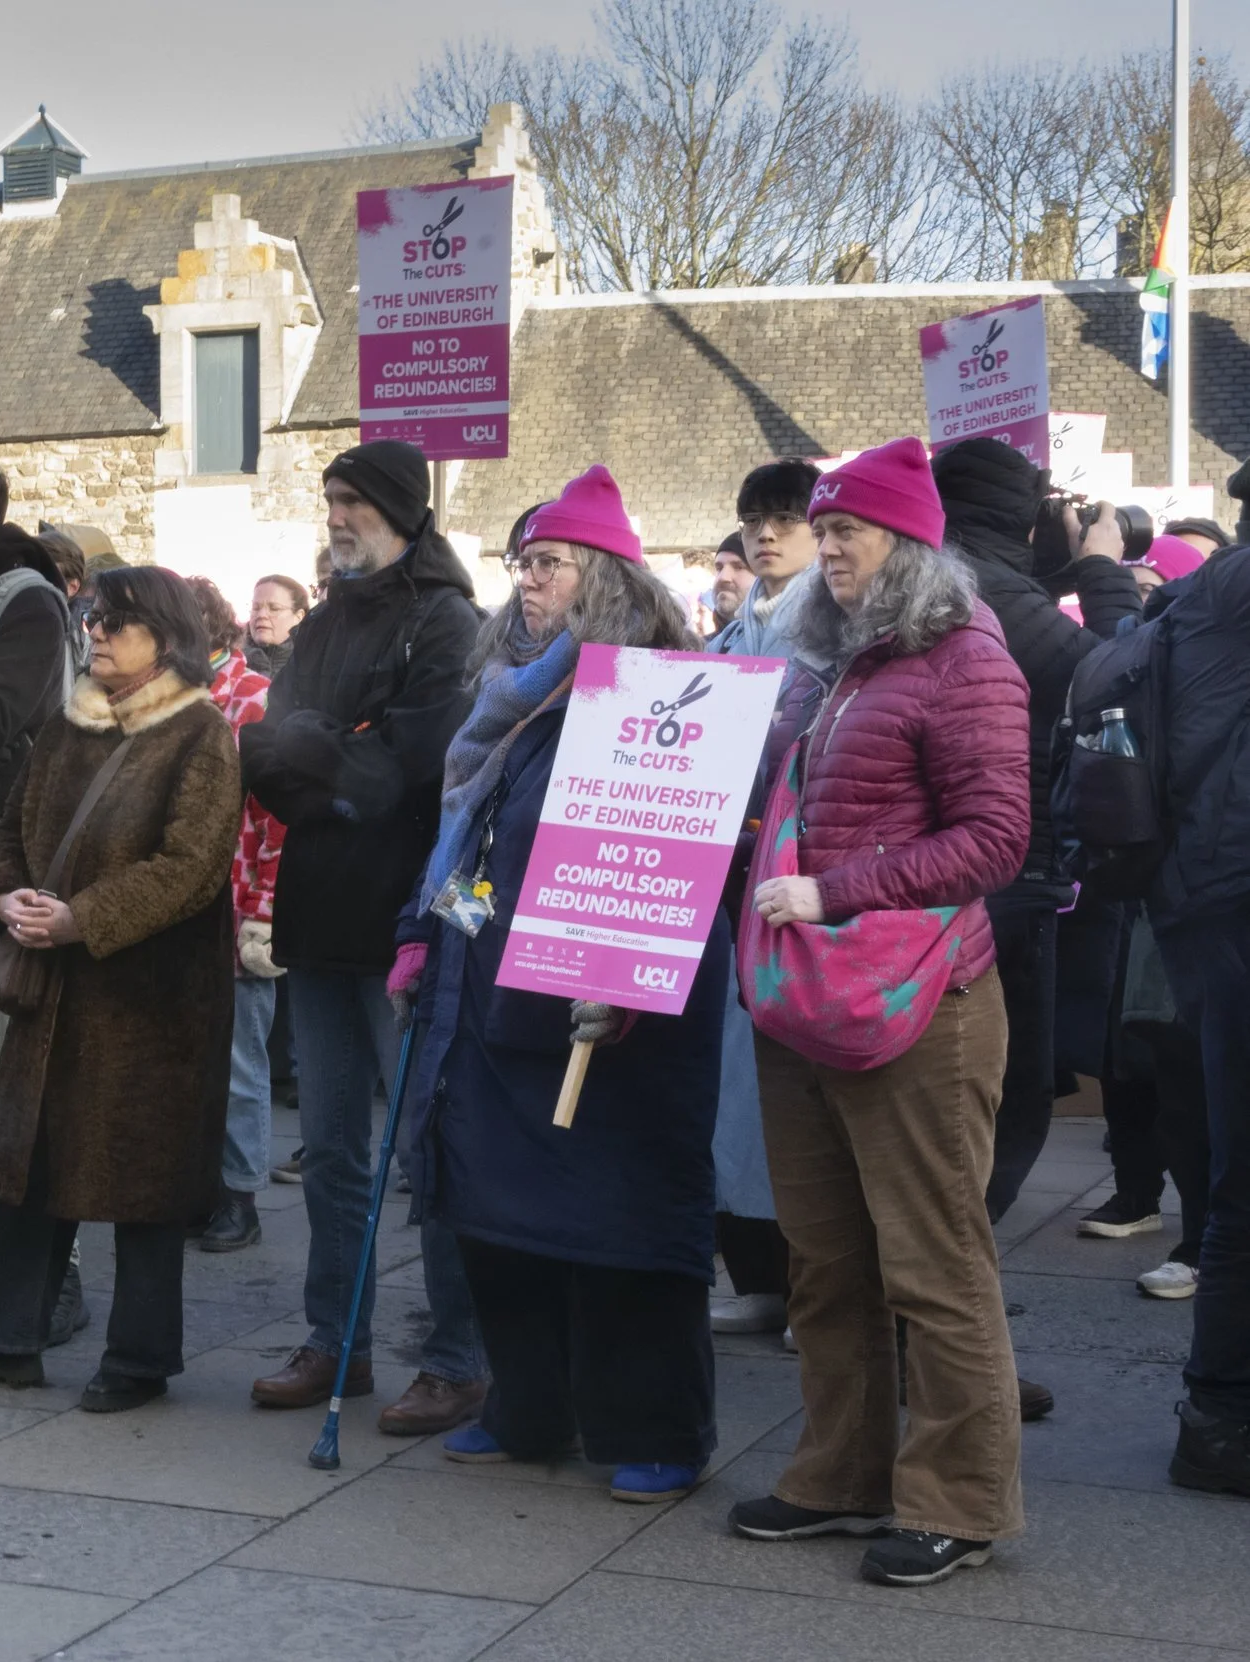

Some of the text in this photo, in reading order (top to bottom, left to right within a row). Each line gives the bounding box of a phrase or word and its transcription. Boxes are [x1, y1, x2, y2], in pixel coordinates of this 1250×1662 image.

[403, 236, 467, 263] STOP
[403, 262, 466, 280] The CUTS:
[372, 293, 403, 309] THE
[407, 284, 498, 307] UNIVERSITY
[377, 306, 494, 329] OF EDINBURGH
[412, 338, 460, 356] NO TO
[382, 355, 489, 378] COMPULSORY
[958, 349, 1009, 379] STOP
[374, 376, 496, 399] REDUNDANCIES!
[959, 371, 1010, 393] The CUTS:
[938, 383, 1038, 421] THE UNIVERSITY
[943, 402, 1036, 436] OF EDINBURGH
[617, 716, 703, 749] STOP
[612, 750, 695, 772] The CUTS:
[553, 776, 730, 811] at THE UNIVERSITY
[564, 802, 717, 837] OF EDINBURGH
[596, 841, 662, 868] NO TO
[554, 863, 694, 900] COMPULSORY
[536, 886, 697, 928] REDUNDANCIES!
[565, 926, 649, 948] SAVE Higher Education
